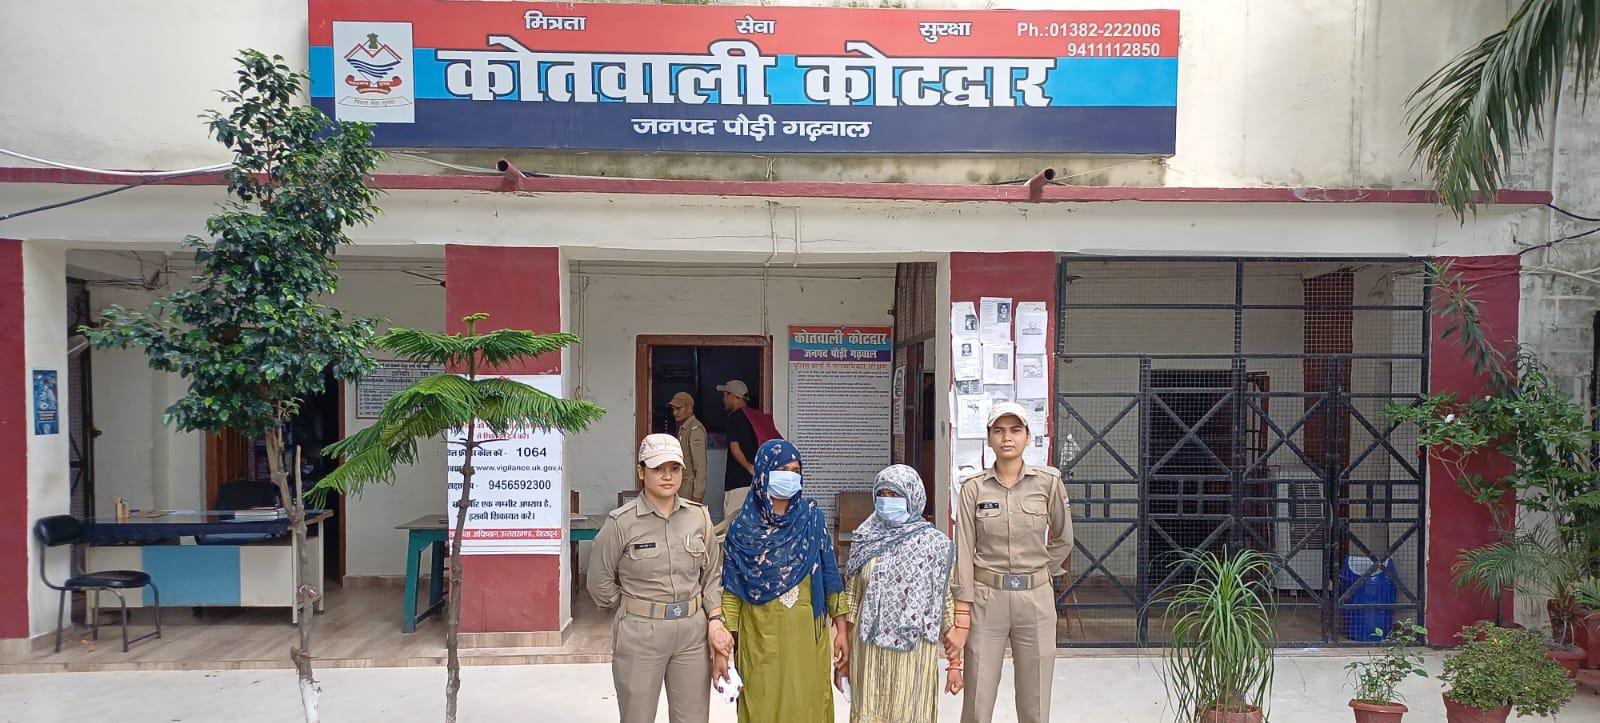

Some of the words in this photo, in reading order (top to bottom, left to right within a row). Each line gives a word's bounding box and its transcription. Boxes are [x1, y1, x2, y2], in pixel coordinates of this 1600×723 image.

[524, 10, 587, 32] मित्रता
[736, 15, 775, 35] सेवा
[919, 20, 972, 42] सुरक्षा
[1016, 22, 1161, 39] Ph.:01382-222006
[1067, 42, 1161, 57] 9411112850
[435, 34, 776, 105] कोतवाली
[795, 40, 1057, 107] कोटद्वार
[631, 117, 718, 136] जनपद
[723, 114, 776, 142] पौड़ी
[782, 121, 873, 142] गढ़वाल
[793, 329, 844, 345] कोतवाली
[847, 330, 887, 345] कोटद्वार
[803, 349, 828, 358] जनपद
[517, 447, 547, 457] 1064
[488, 479, 551, 490] 9456592300
[490, 510, 519, 520] शिकायत
